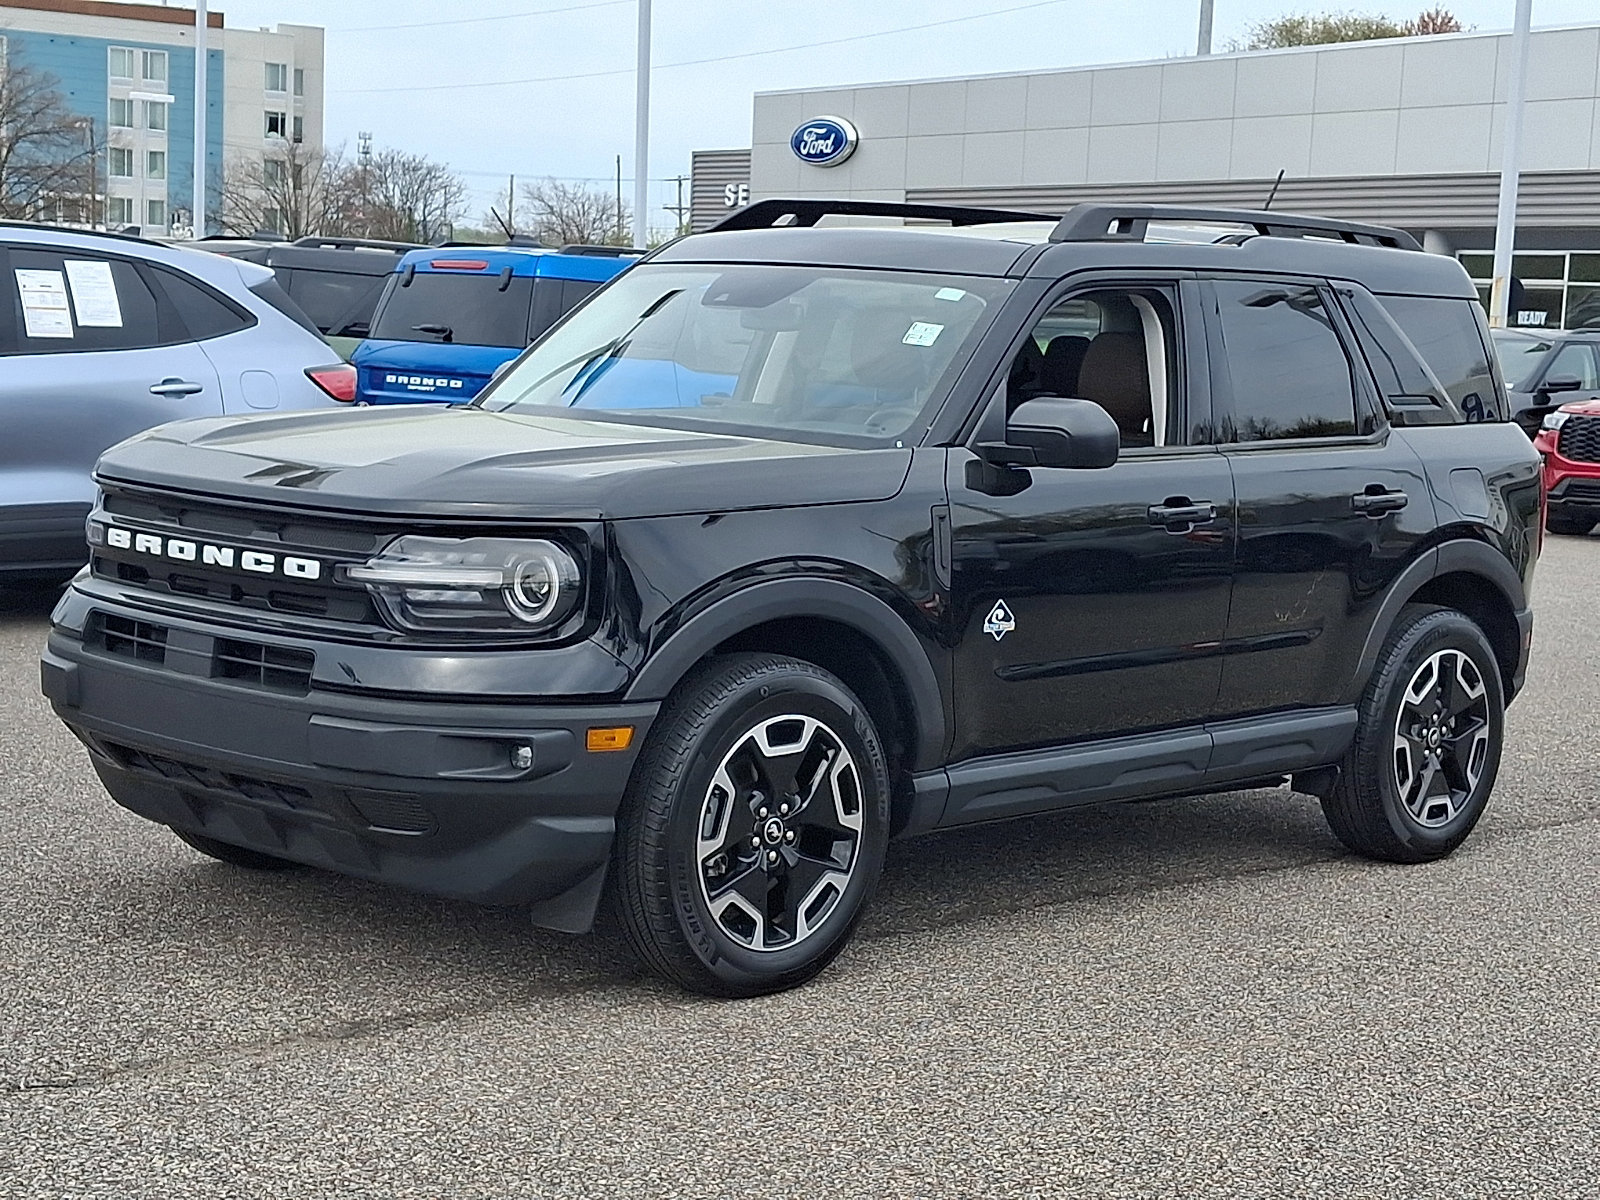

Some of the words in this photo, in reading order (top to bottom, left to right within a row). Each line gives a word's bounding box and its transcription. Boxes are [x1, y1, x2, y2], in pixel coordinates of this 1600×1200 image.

[799, 127, 836, 155] Ford
[724, 183, 750, 207] SE
[1517, 310, 1548, 326] READY
[386, 375, 463, 389] BRONCO
[407, 384, 437, 392] SPORT
[107, 527, 321, 580] BRONCO
